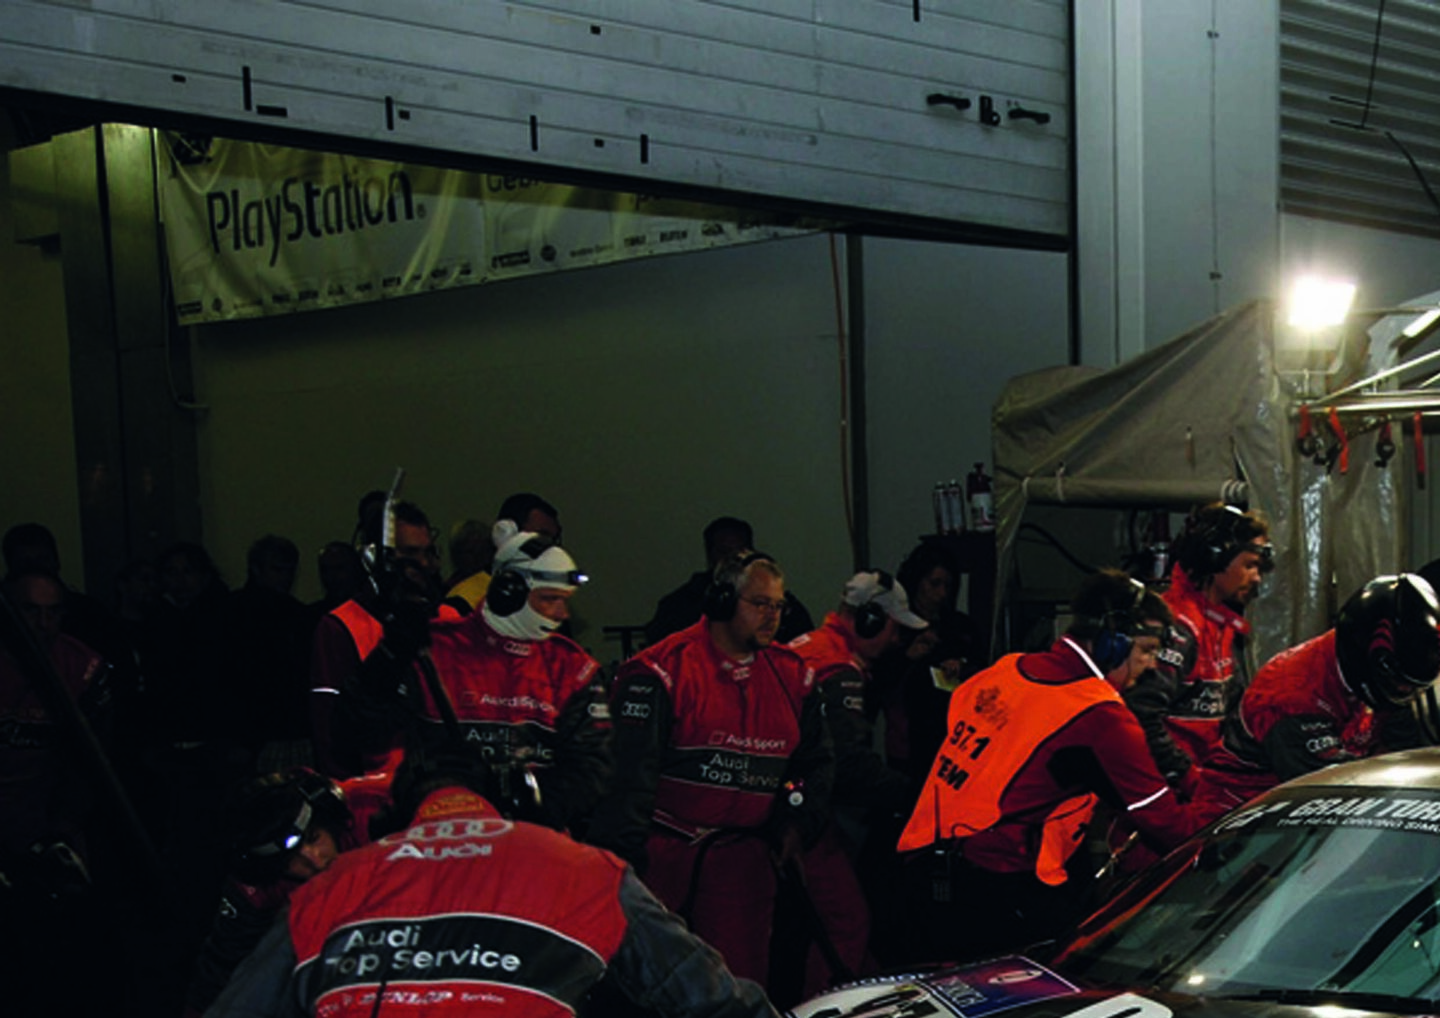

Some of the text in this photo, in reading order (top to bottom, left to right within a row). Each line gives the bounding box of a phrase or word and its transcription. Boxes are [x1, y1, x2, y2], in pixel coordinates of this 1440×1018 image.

[207, 170, 413, 266] PlayStation
[699, 764, 734, 784] Top
[1288, 797, 1385, 818] GRAN
[385, 843, 493, 862] Audi
[344, 925, 422, 952] Audi
[390, 943, 522, 972] Service
